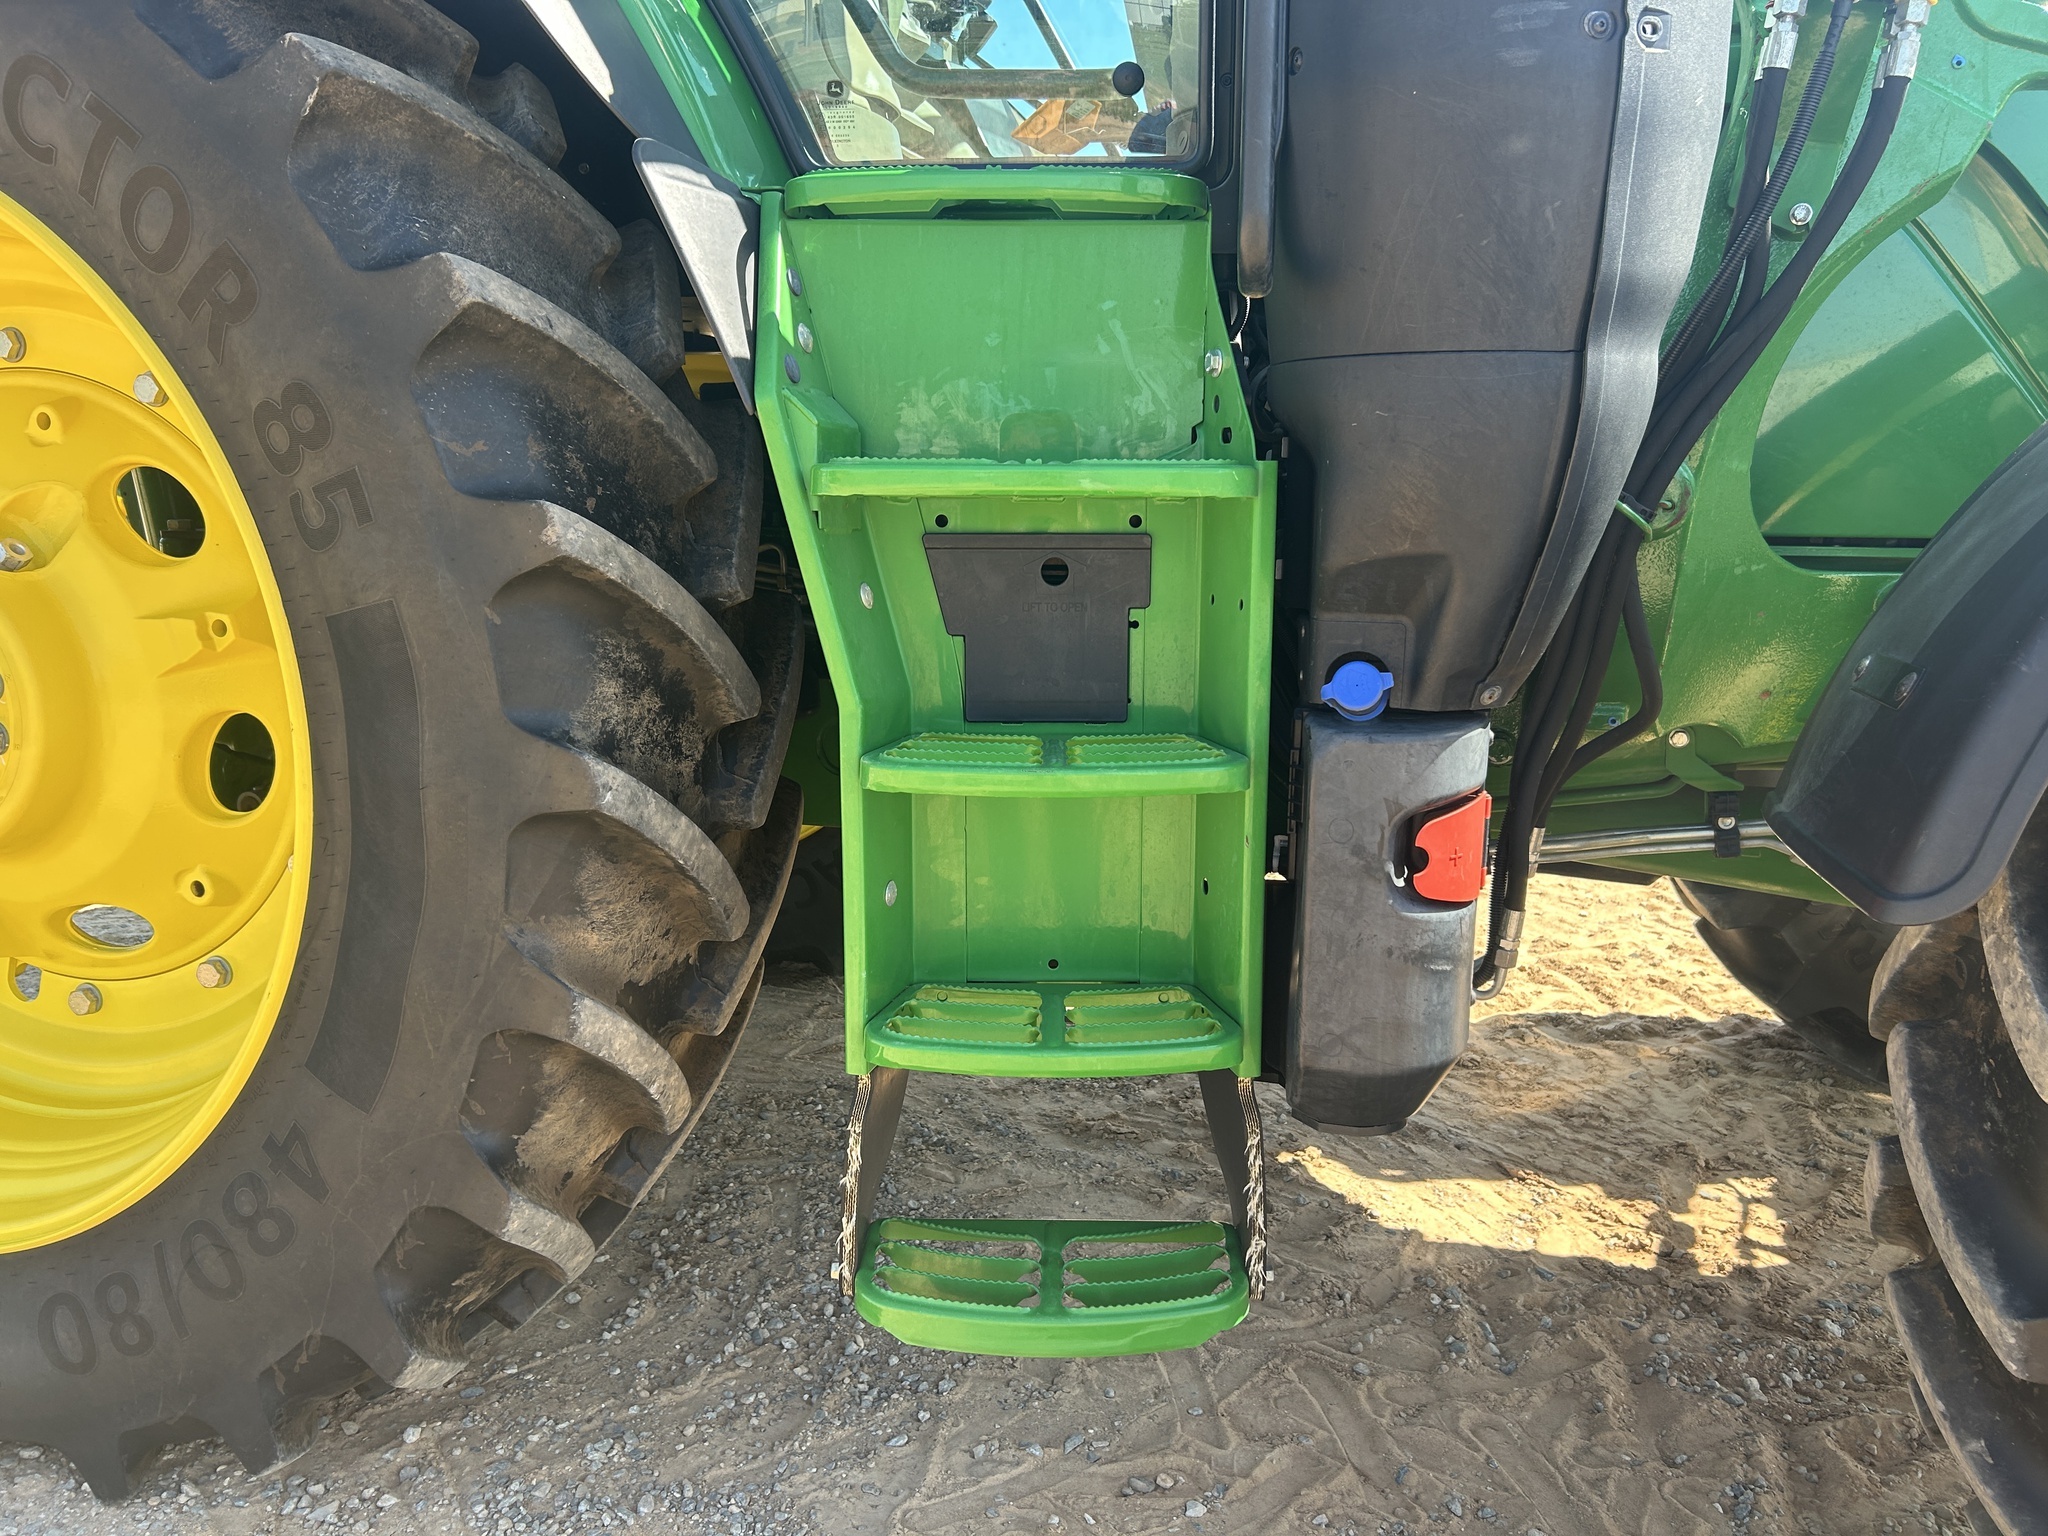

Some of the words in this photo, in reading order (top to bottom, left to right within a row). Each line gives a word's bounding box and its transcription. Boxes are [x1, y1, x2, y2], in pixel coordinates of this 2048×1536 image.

[252, 380, 376, 554] 85
[1022, 602, 1041, 612] LIFT
[1045, 602, 1057, 612] TO
[1060, 602, 1087, 612] OPEN
[38, 1120, 332, 1376] 480/80
